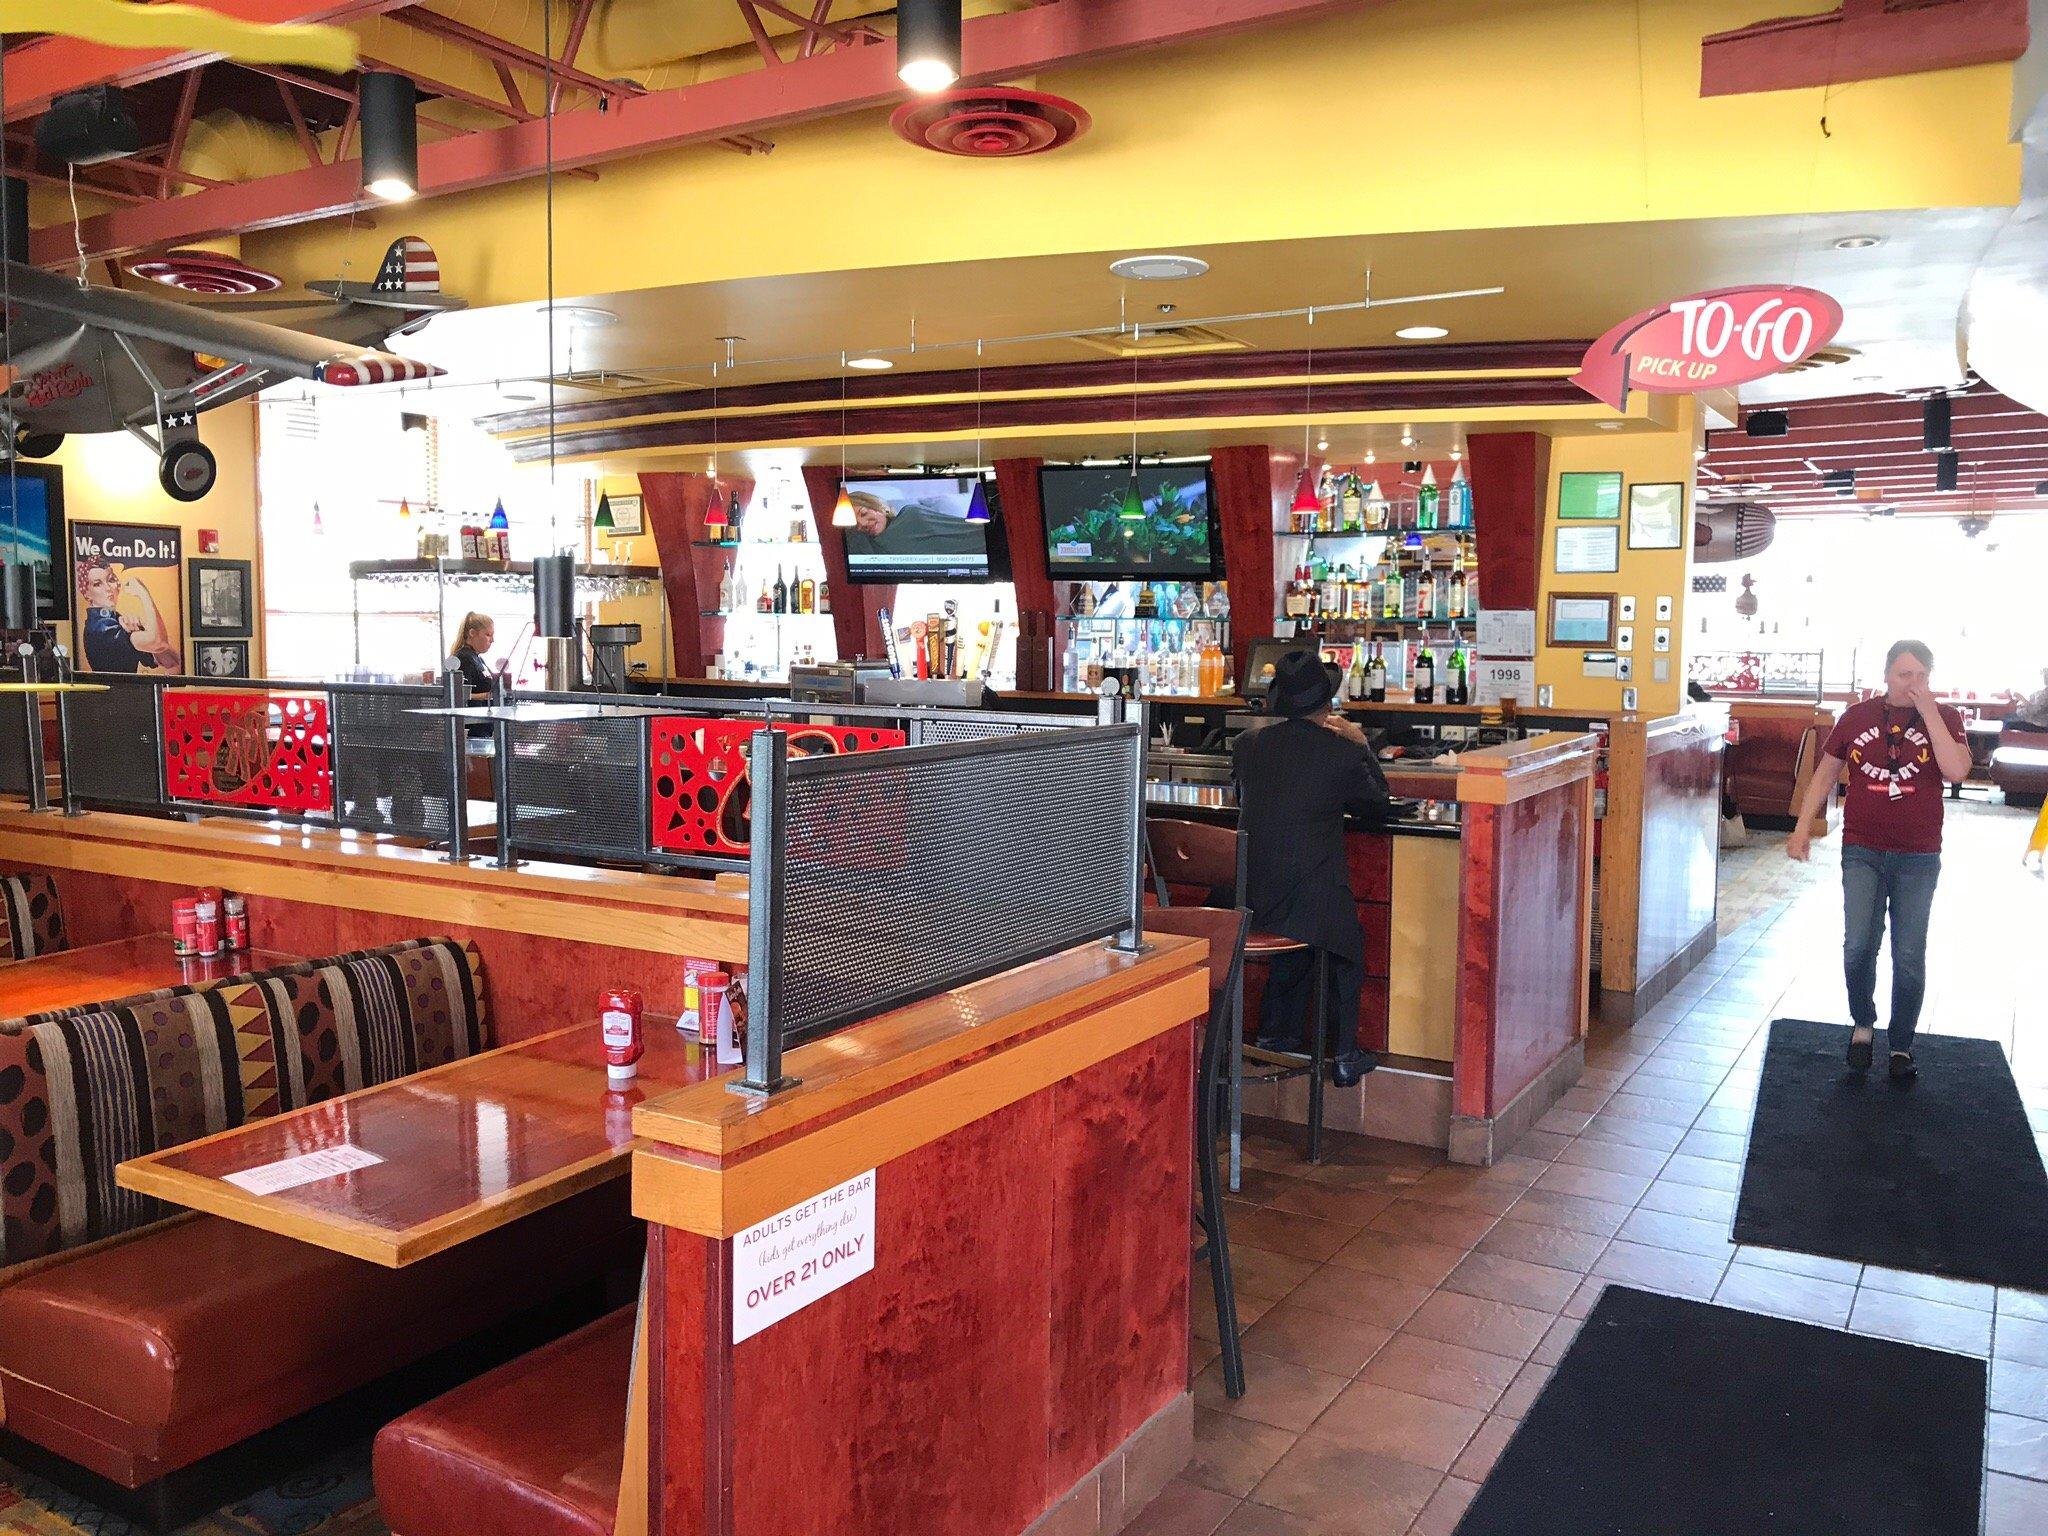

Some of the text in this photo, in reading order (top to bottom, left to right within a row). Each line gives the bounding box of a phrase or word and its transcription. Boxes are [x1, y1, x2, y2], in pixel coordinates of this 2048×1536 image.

[1669, 298, 1813, 363] TO-GO
[1637, 355, 1718, 380] PICK UP
[75, 536, 176, 559] We Can Do It!
[1490, 669, 1521, 681] 1998
[1853, 726, 1880, 747] FRY
[1903, 727, 1929, 746] EAT
[742, 1176, 871, 1248] ADULTS GET THE BAR
[782, 1237, 796, 1260] get
[797, 1220, 838, 1247] everything
[746, 1233, 865, 1308] OVER 21 ONLY
